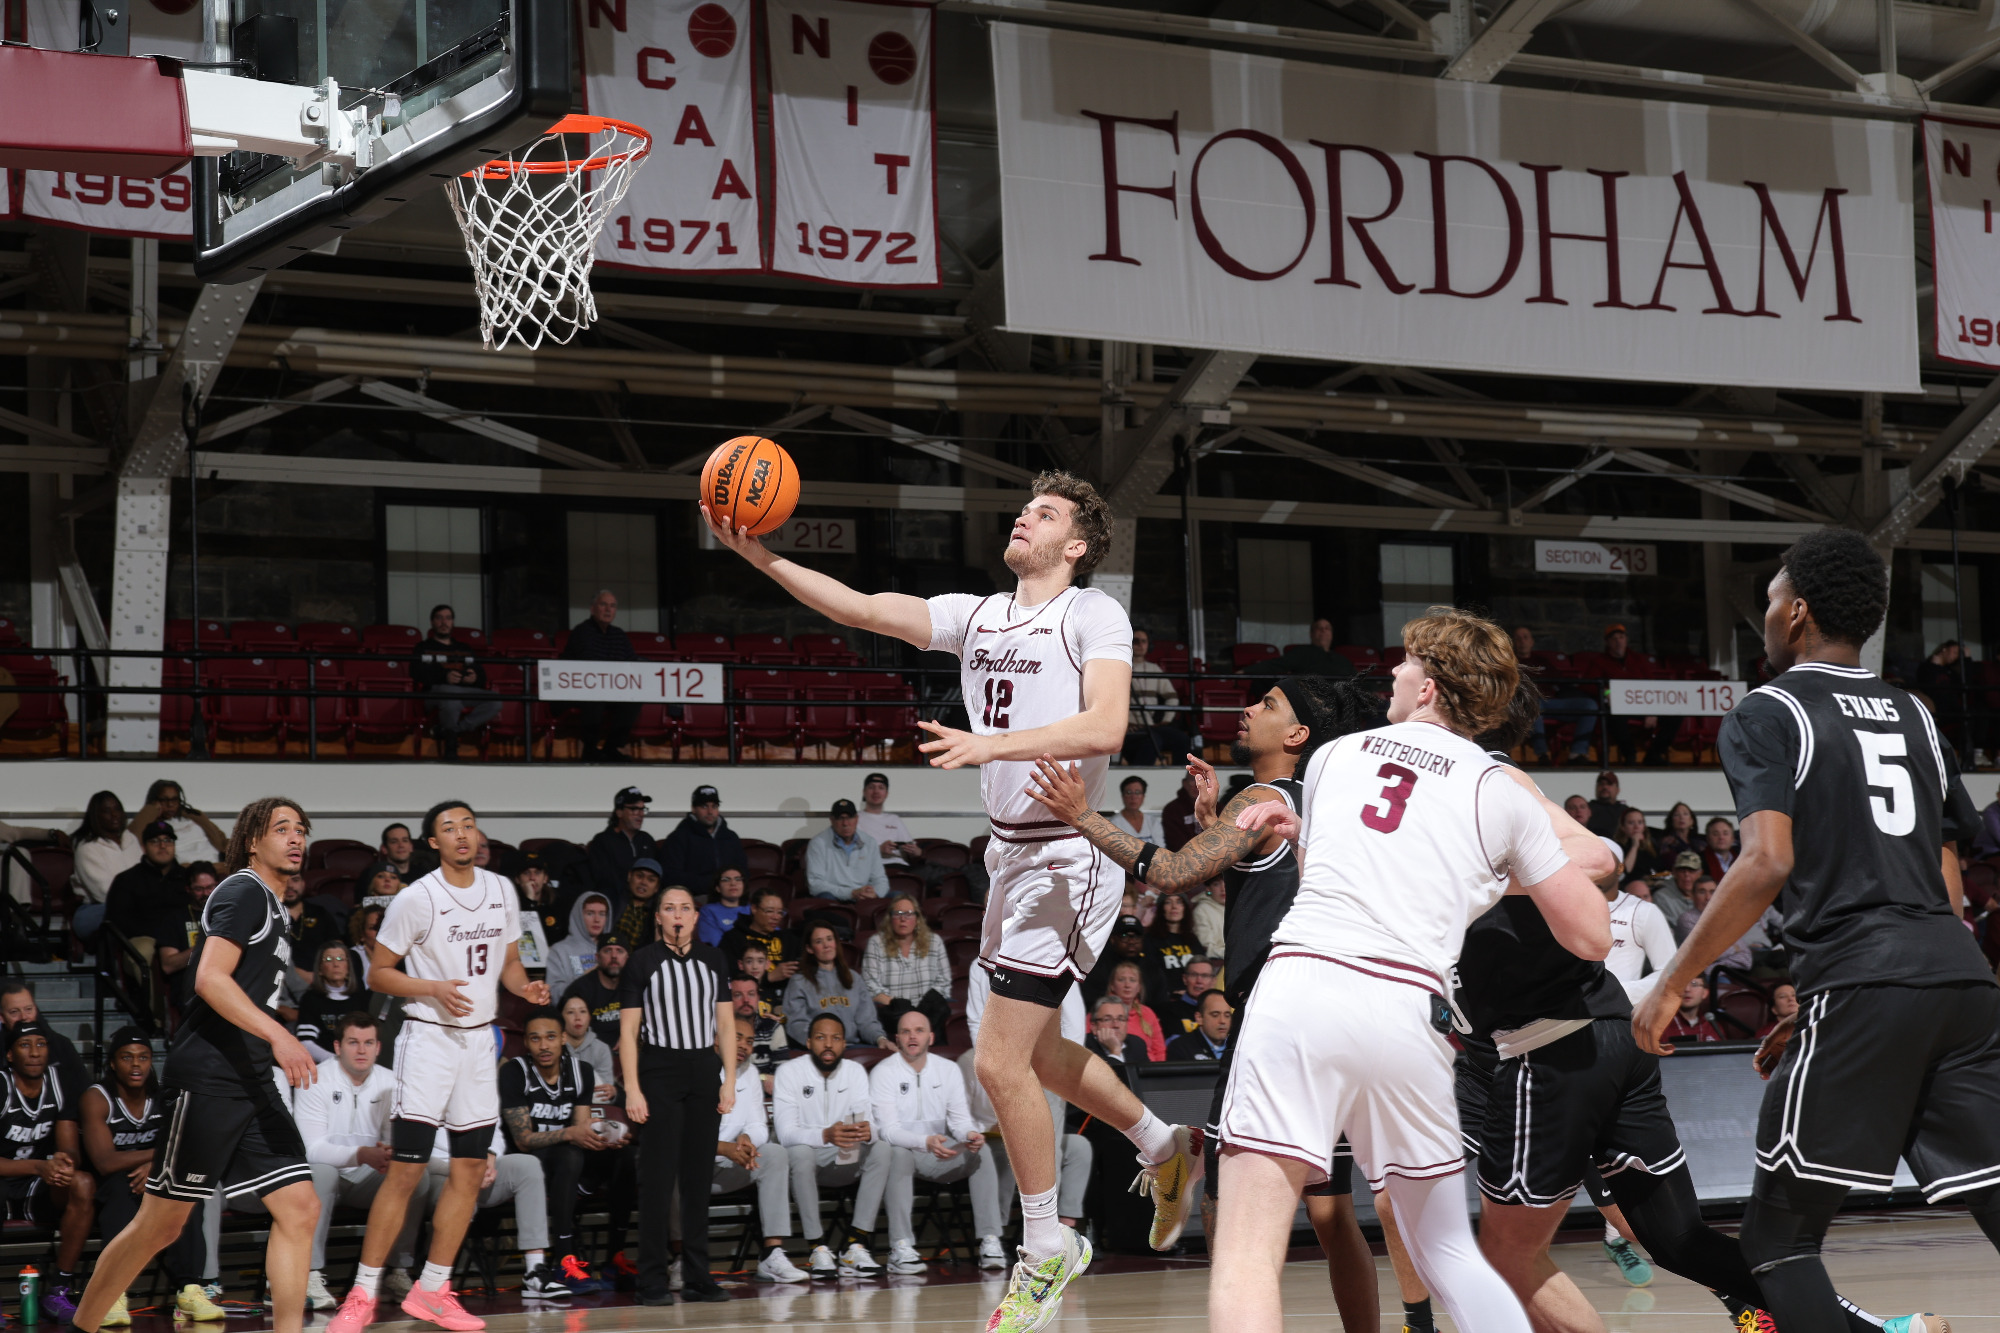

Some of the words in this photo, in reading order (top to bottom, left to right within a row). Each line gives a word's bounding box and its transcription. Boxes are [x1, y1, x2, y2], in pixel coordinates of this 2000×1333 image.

[51, 171, 192, 213] 1969
[1080, 109, 1863, 324] FORDHAM
[615, 215, 739, 256] 1971
[797, 222, 918, 265] 1972
[1957, 314, 2000, 347] 19
[714, 443, 750, 507] Wilson
[744, 457, 773, 508] NCAA
[793, 521, 845, 549] 212
[1545, 549, 1602, 565] SECTION
[1608, 546, 1648, 573] 213
[557, 671, 643, 690] SECTION
[654, 667, 705, 698] 112
[1624, 689, 1688, 705] SECTION
[1696, 685, 1735, 712] 113
[982, 677, 1015, 729] 12
[1832, 692, 1901, 722] EVANS
[1360, 735, 1457, 778] WHITBOURN
[1359, 761, 1420, 835] 3
[1852, 728, 1917, 837] 5
[447, 921, 503, 943] Fordham
[465, 943, 489, 977] 13
[819, 996, 851, 1010] VCU
[529, 1102, 573, 1121] RAMS
[4, 1120, 54, 1143] RAMS
[112, 1128, 159, 1146] RAMS
[185, 1172, 207, 1184] VCU
